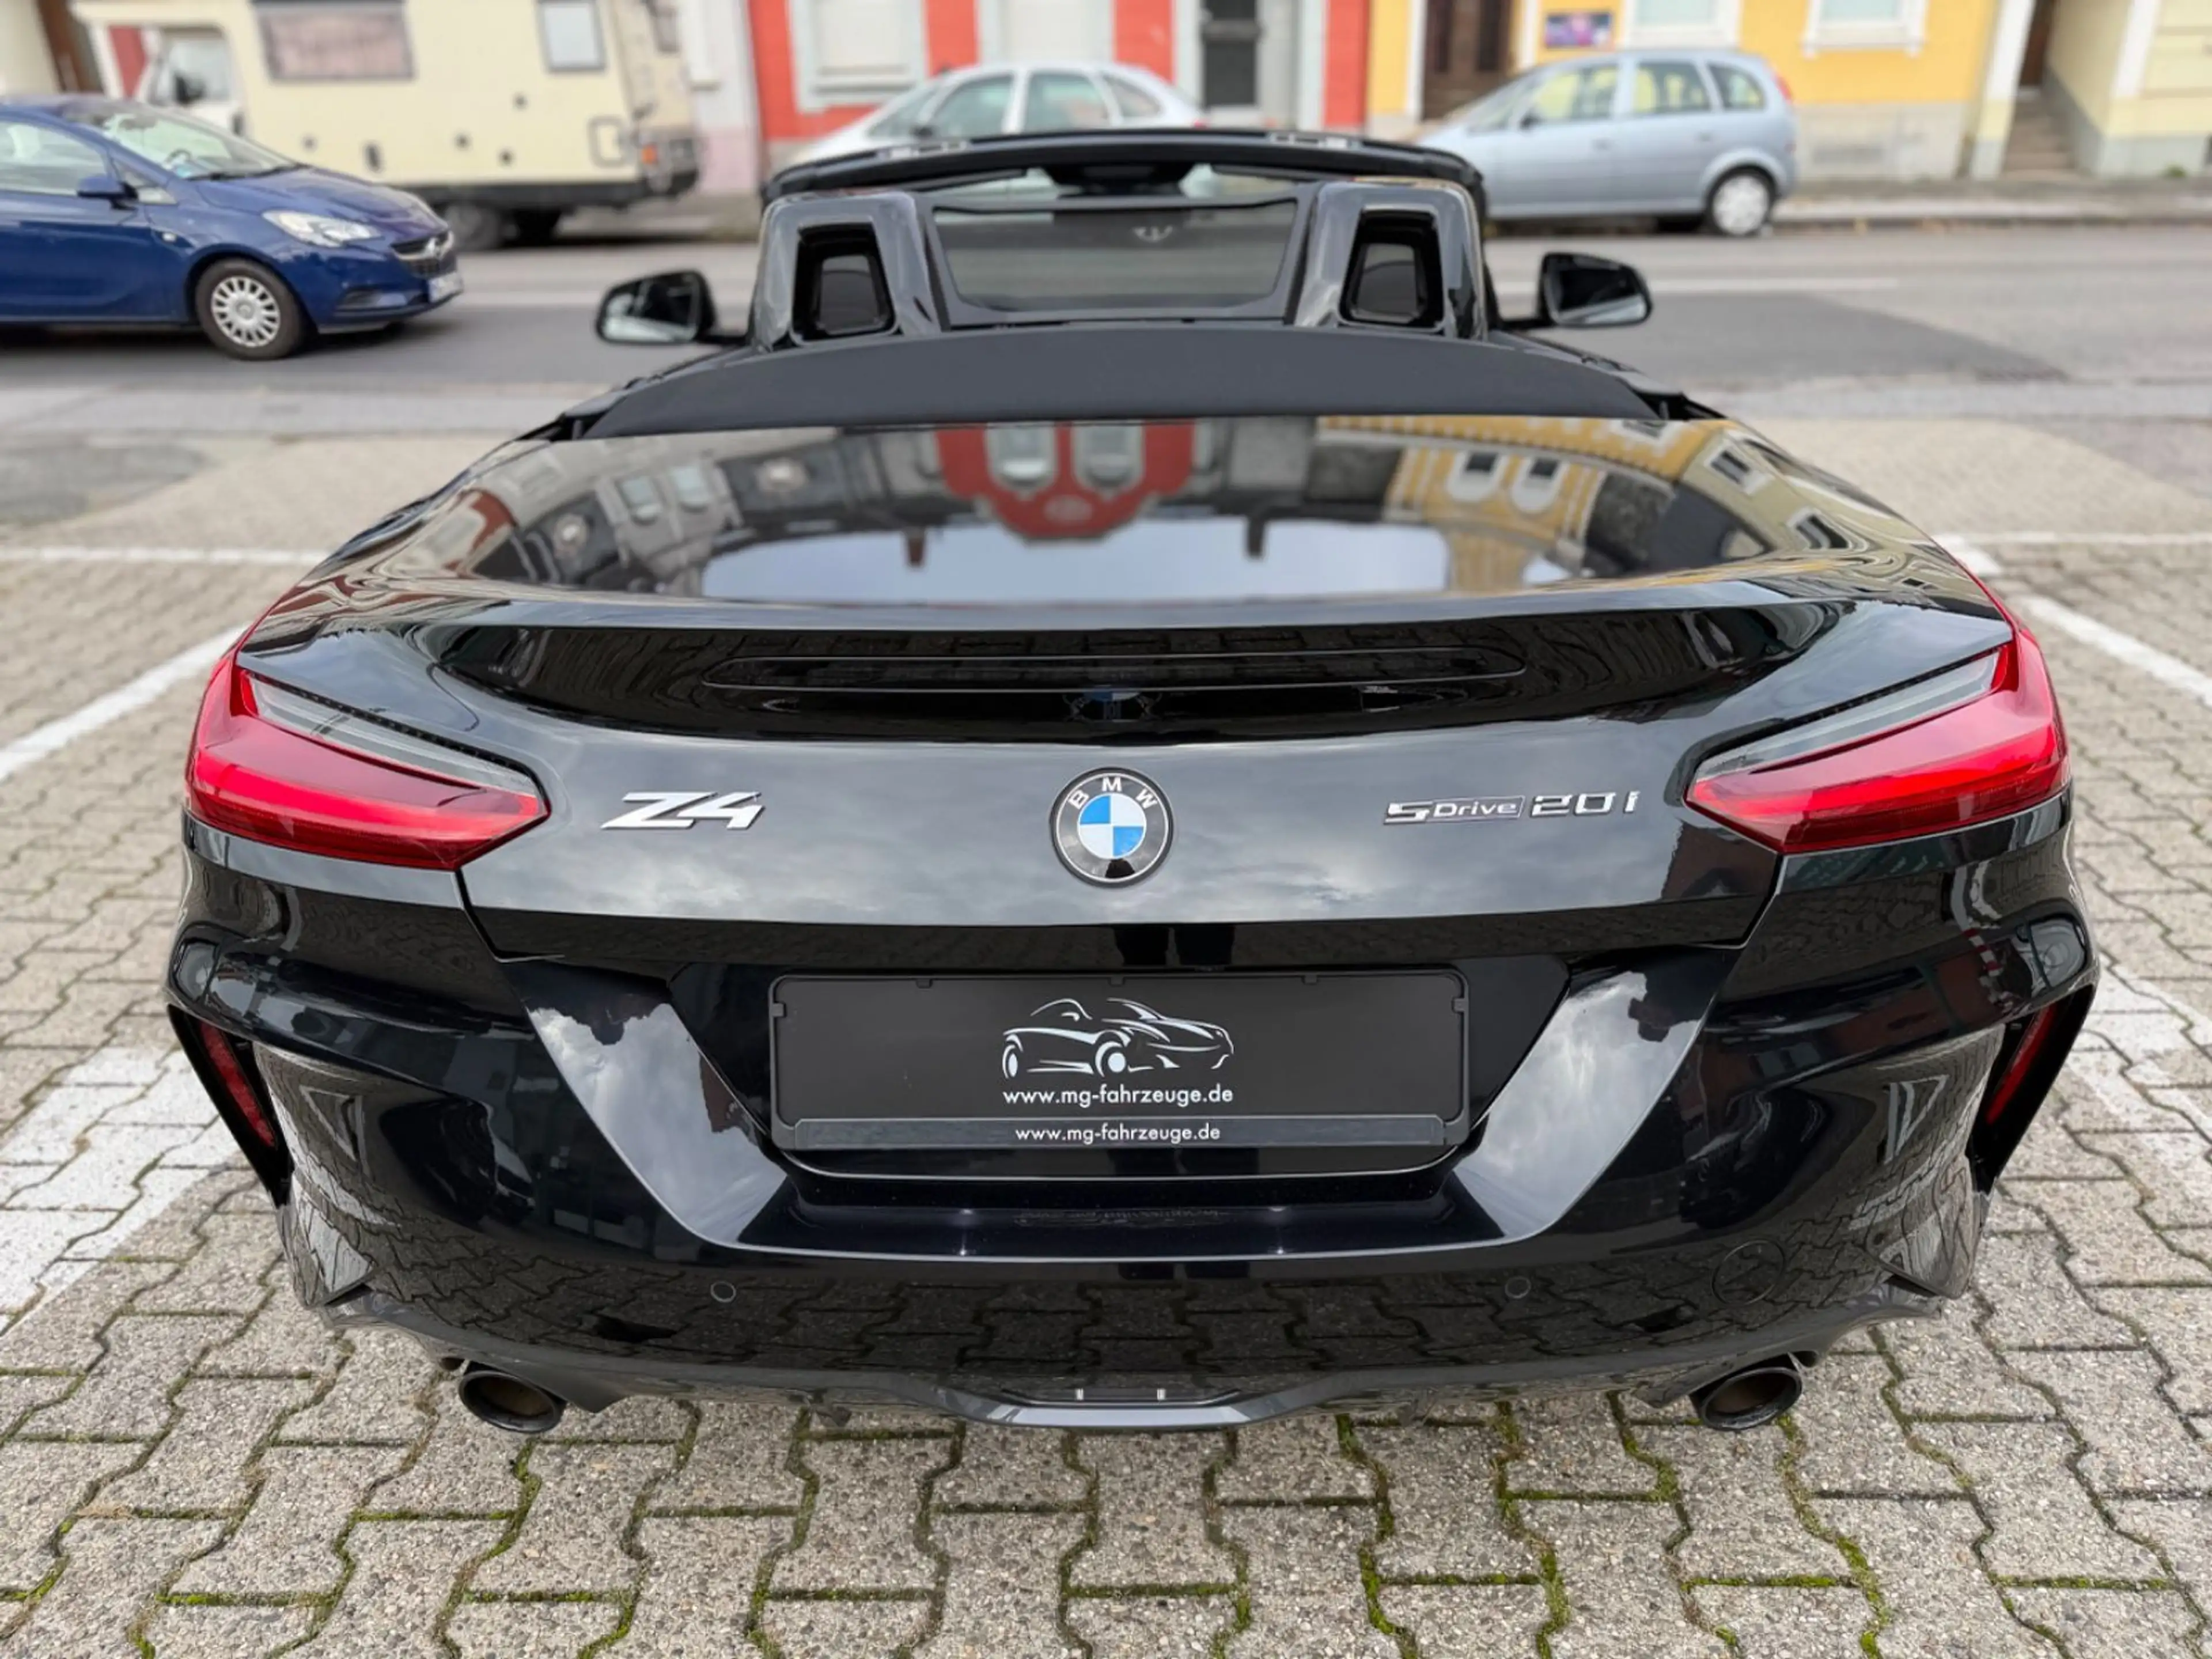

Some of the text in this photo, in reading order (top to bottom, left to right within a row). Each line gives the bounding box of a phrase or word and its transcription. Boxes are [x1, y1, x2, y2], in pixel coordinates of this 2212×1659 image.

[1068, 777, 1157, 809] BMW
[601, 791, 764, 830] Z4
[1002, 1084, 1233, 1108] www.mg-fahrzeuge.de
[1016, 1123, 1221, 1145] www.mg-fahrzeuge.de
